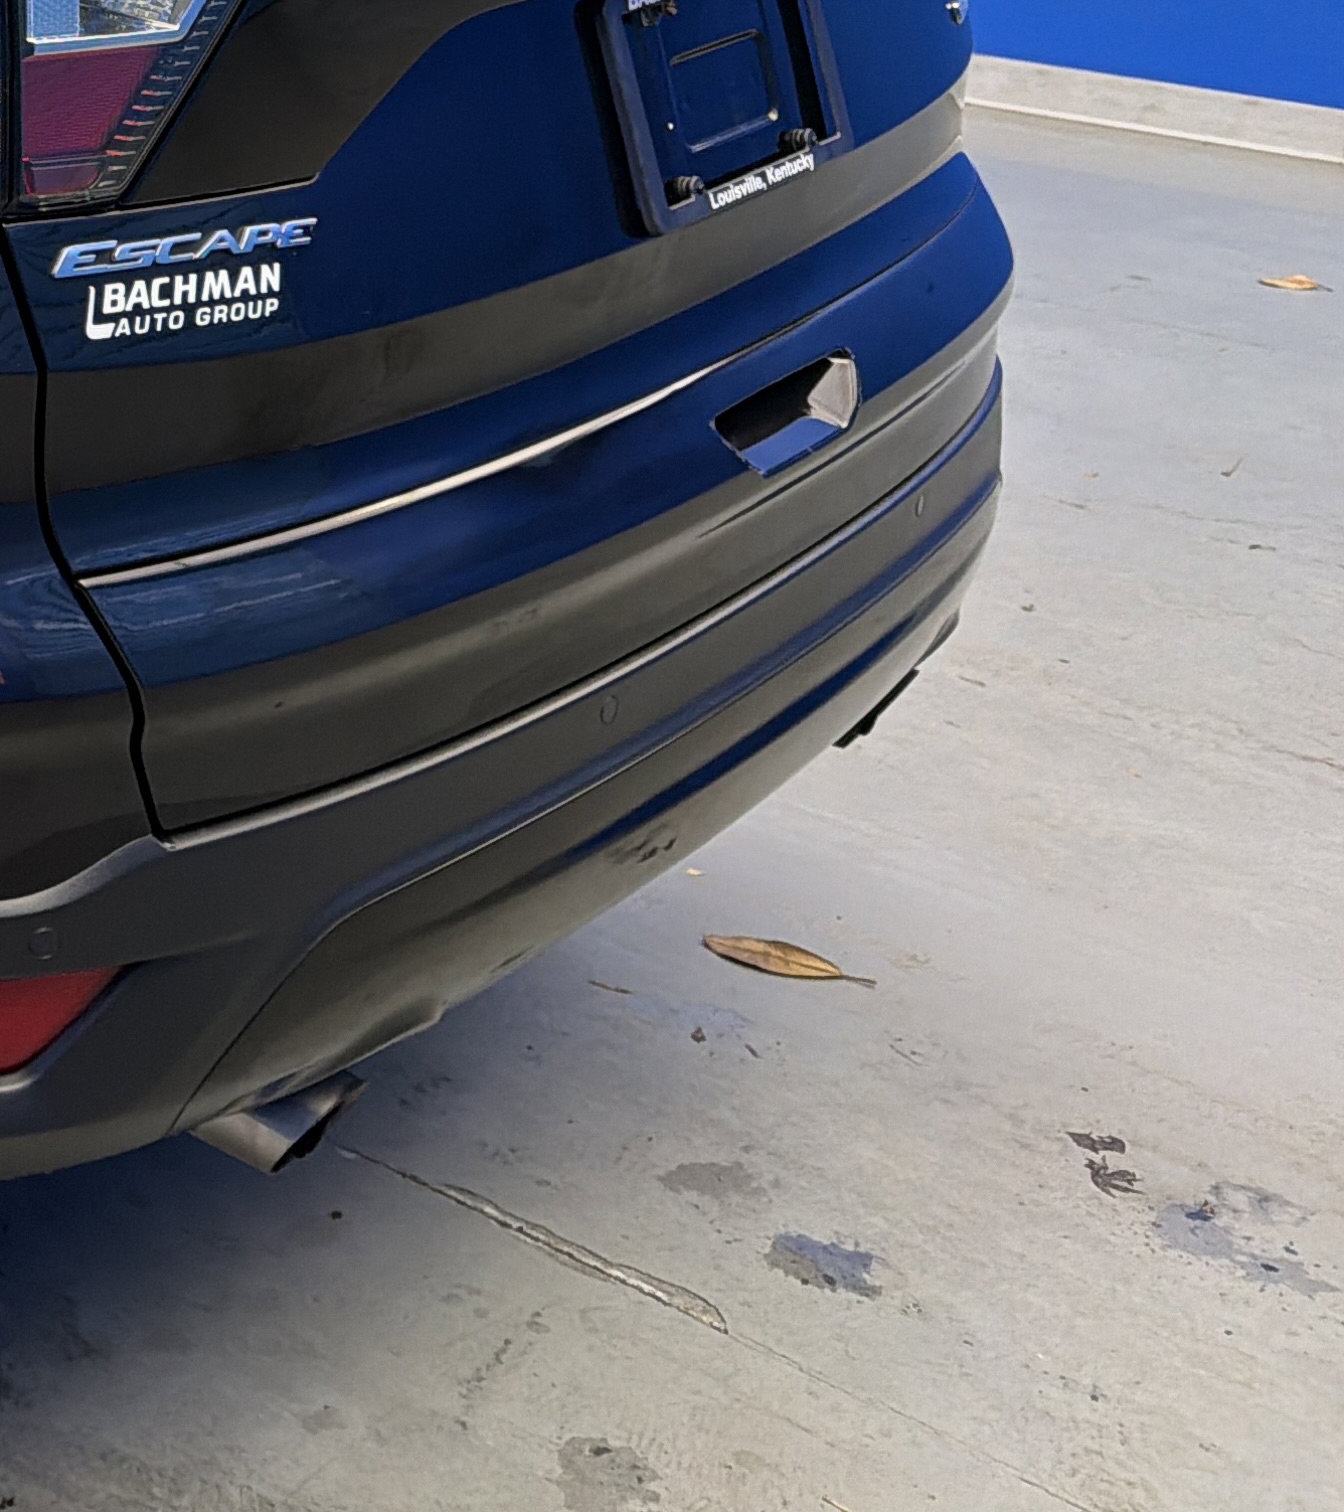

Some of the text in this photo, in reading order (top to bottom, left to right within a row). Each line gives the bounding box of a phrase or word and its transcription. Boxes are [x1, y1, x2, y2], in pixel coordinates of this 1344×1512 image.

[708, 153, 814, 209] Louisville, Kentucky
[52, 217, 317, 278] ESCAPE
[102, 262, 281, 314] BACHMAN
[115, 298, 279, 337] AUTO GROUP
